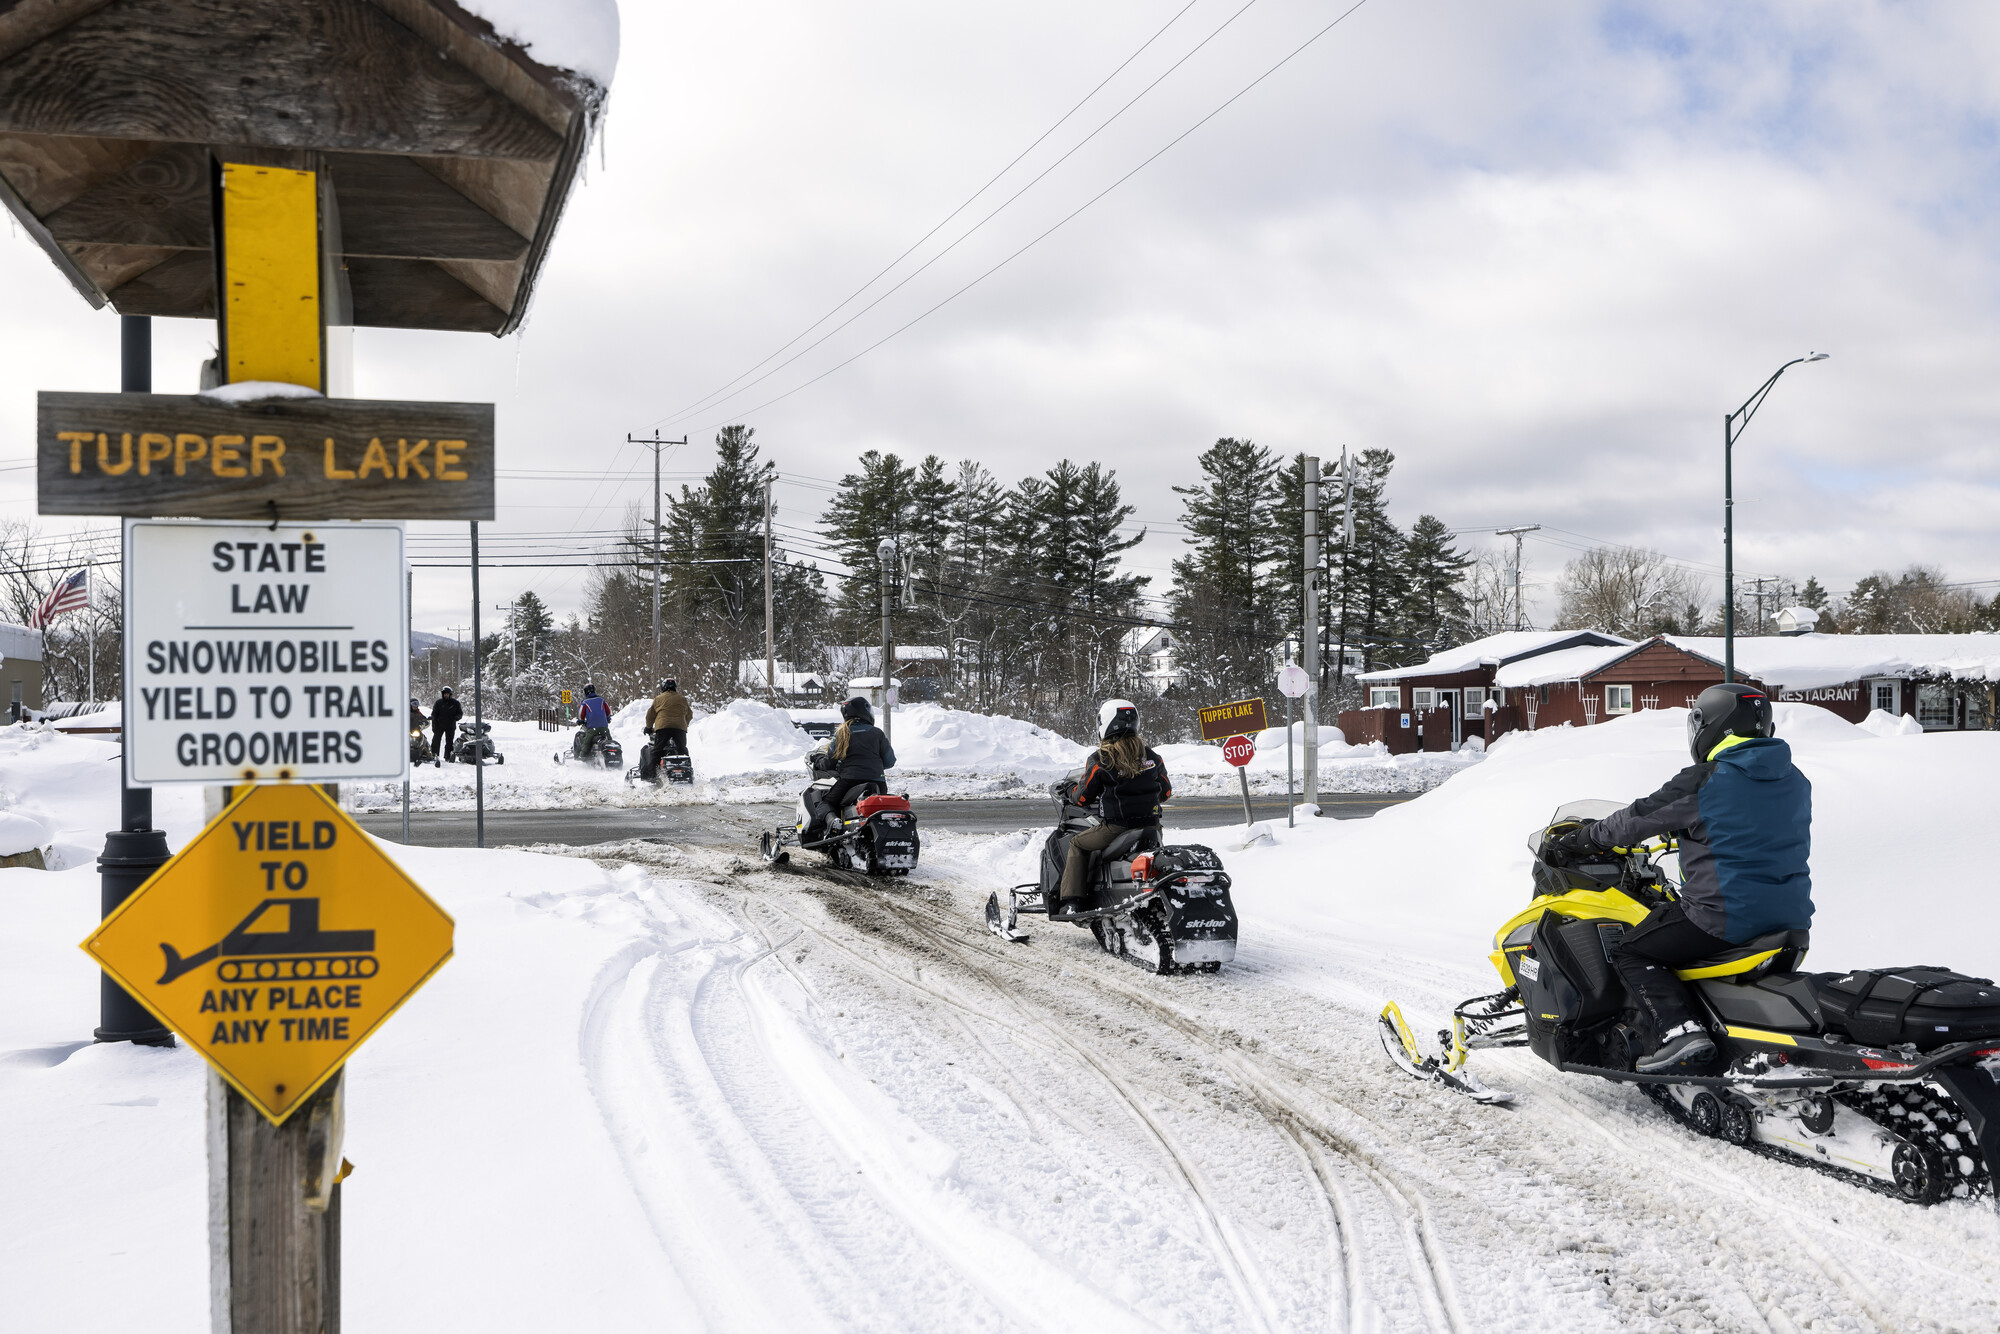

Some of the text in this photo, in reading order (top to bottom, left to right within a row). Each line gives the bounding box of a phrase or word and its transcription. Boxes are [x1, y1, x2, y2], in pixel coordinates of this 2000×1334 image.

[57, 431, 469, 482] TUPPER LAKE
[212, 541, 327, 573] STATE
[231, 584, 310, 615] LAW
[146, 640, 390, 675] SNOWMOBILES
[141, 684, 393, 721] YIELD TO TRAIL
[1778, 689, 1860, 701] RESTAURANT
[1202, 703, 1254, 723] TUPPER LAKE
[177, 730, 363, 766] GROOMERS
[1224, 743, 1253, 759] STOP
[232, 820, 338, 851] YIELD
[884, 840, 913, 848] ski-doo
[260, 860, 309, 891] TO
[1185, 919, 1226, 929] ski-doo
[199, 984, 362, 1013] ANY PLACE
[210, 1016, 350, 1045] ANY TIME
